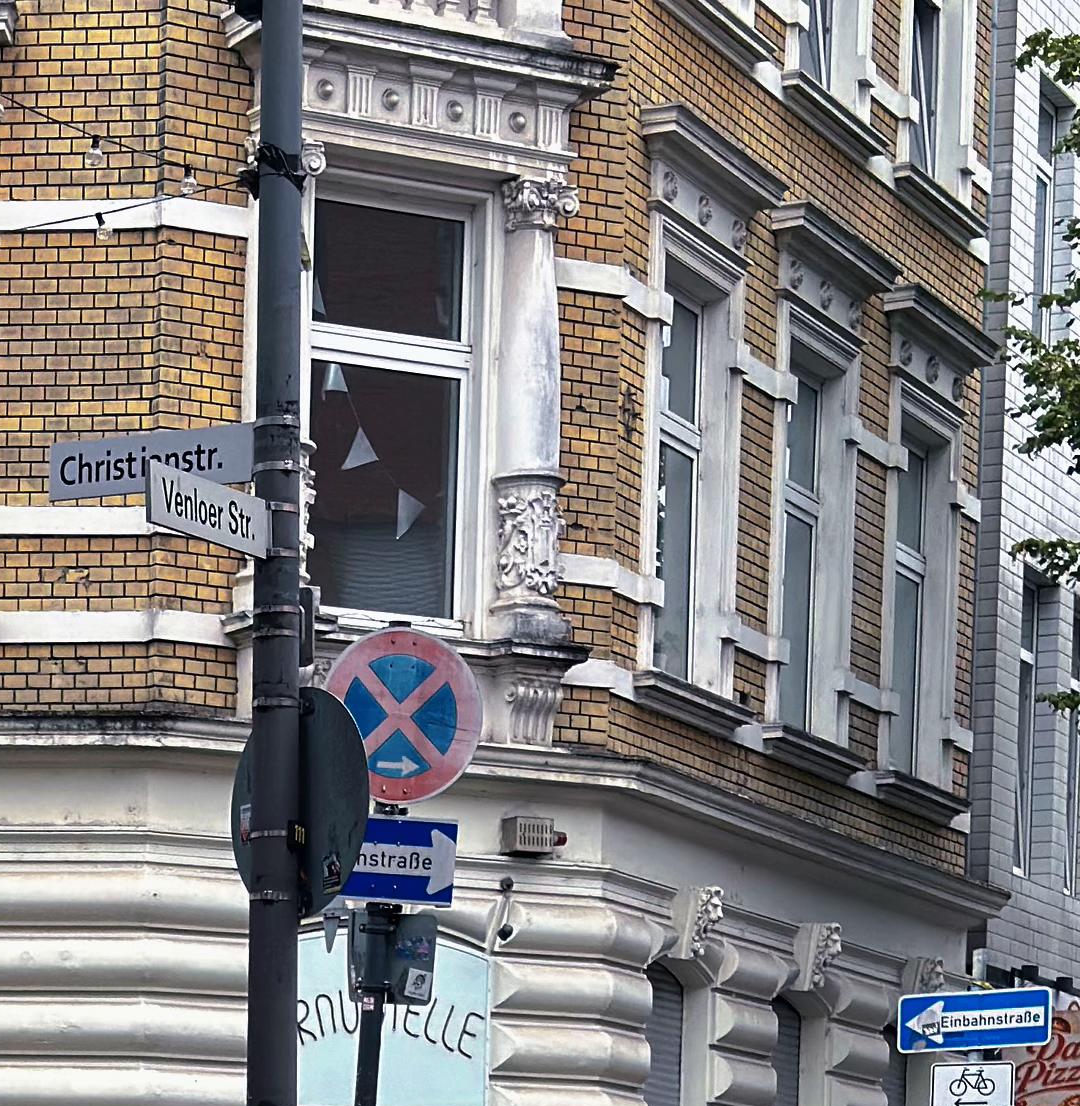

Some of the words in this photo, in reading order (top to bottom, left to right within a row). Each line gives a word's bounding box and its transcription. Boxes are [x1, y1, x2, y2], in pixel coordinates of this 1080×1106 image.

[162, 477, 223, 530] Venloer
[228, 500, 255, 541] Str.
[940, 1011, 1041, 1029] Einbahnstraße
